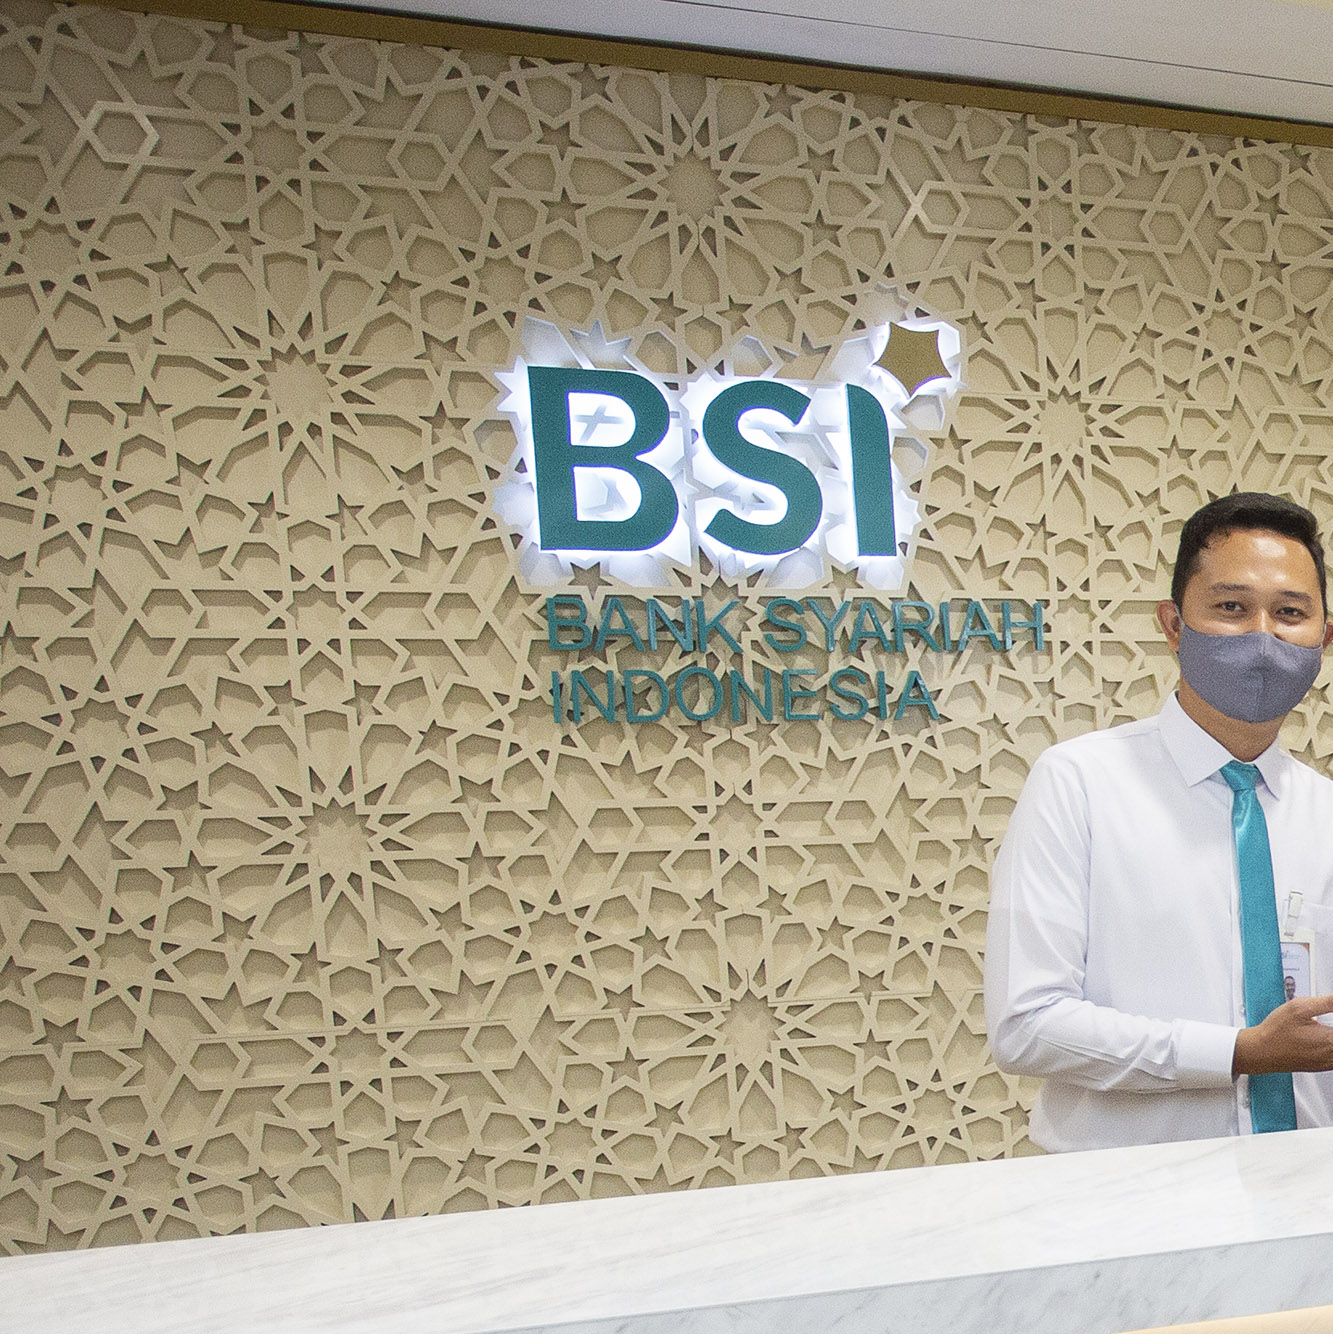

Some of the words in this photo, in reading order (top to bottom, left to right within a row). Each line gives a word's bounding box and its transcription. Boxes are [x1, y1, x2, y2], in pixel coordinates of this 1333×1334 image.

[527, 364, 898, 557] BSI
[546, 597, 744, 653] BANK
[763, 598, 1045, 653] SYARIAH
[550, 666, 942, 723] INDONESIA
